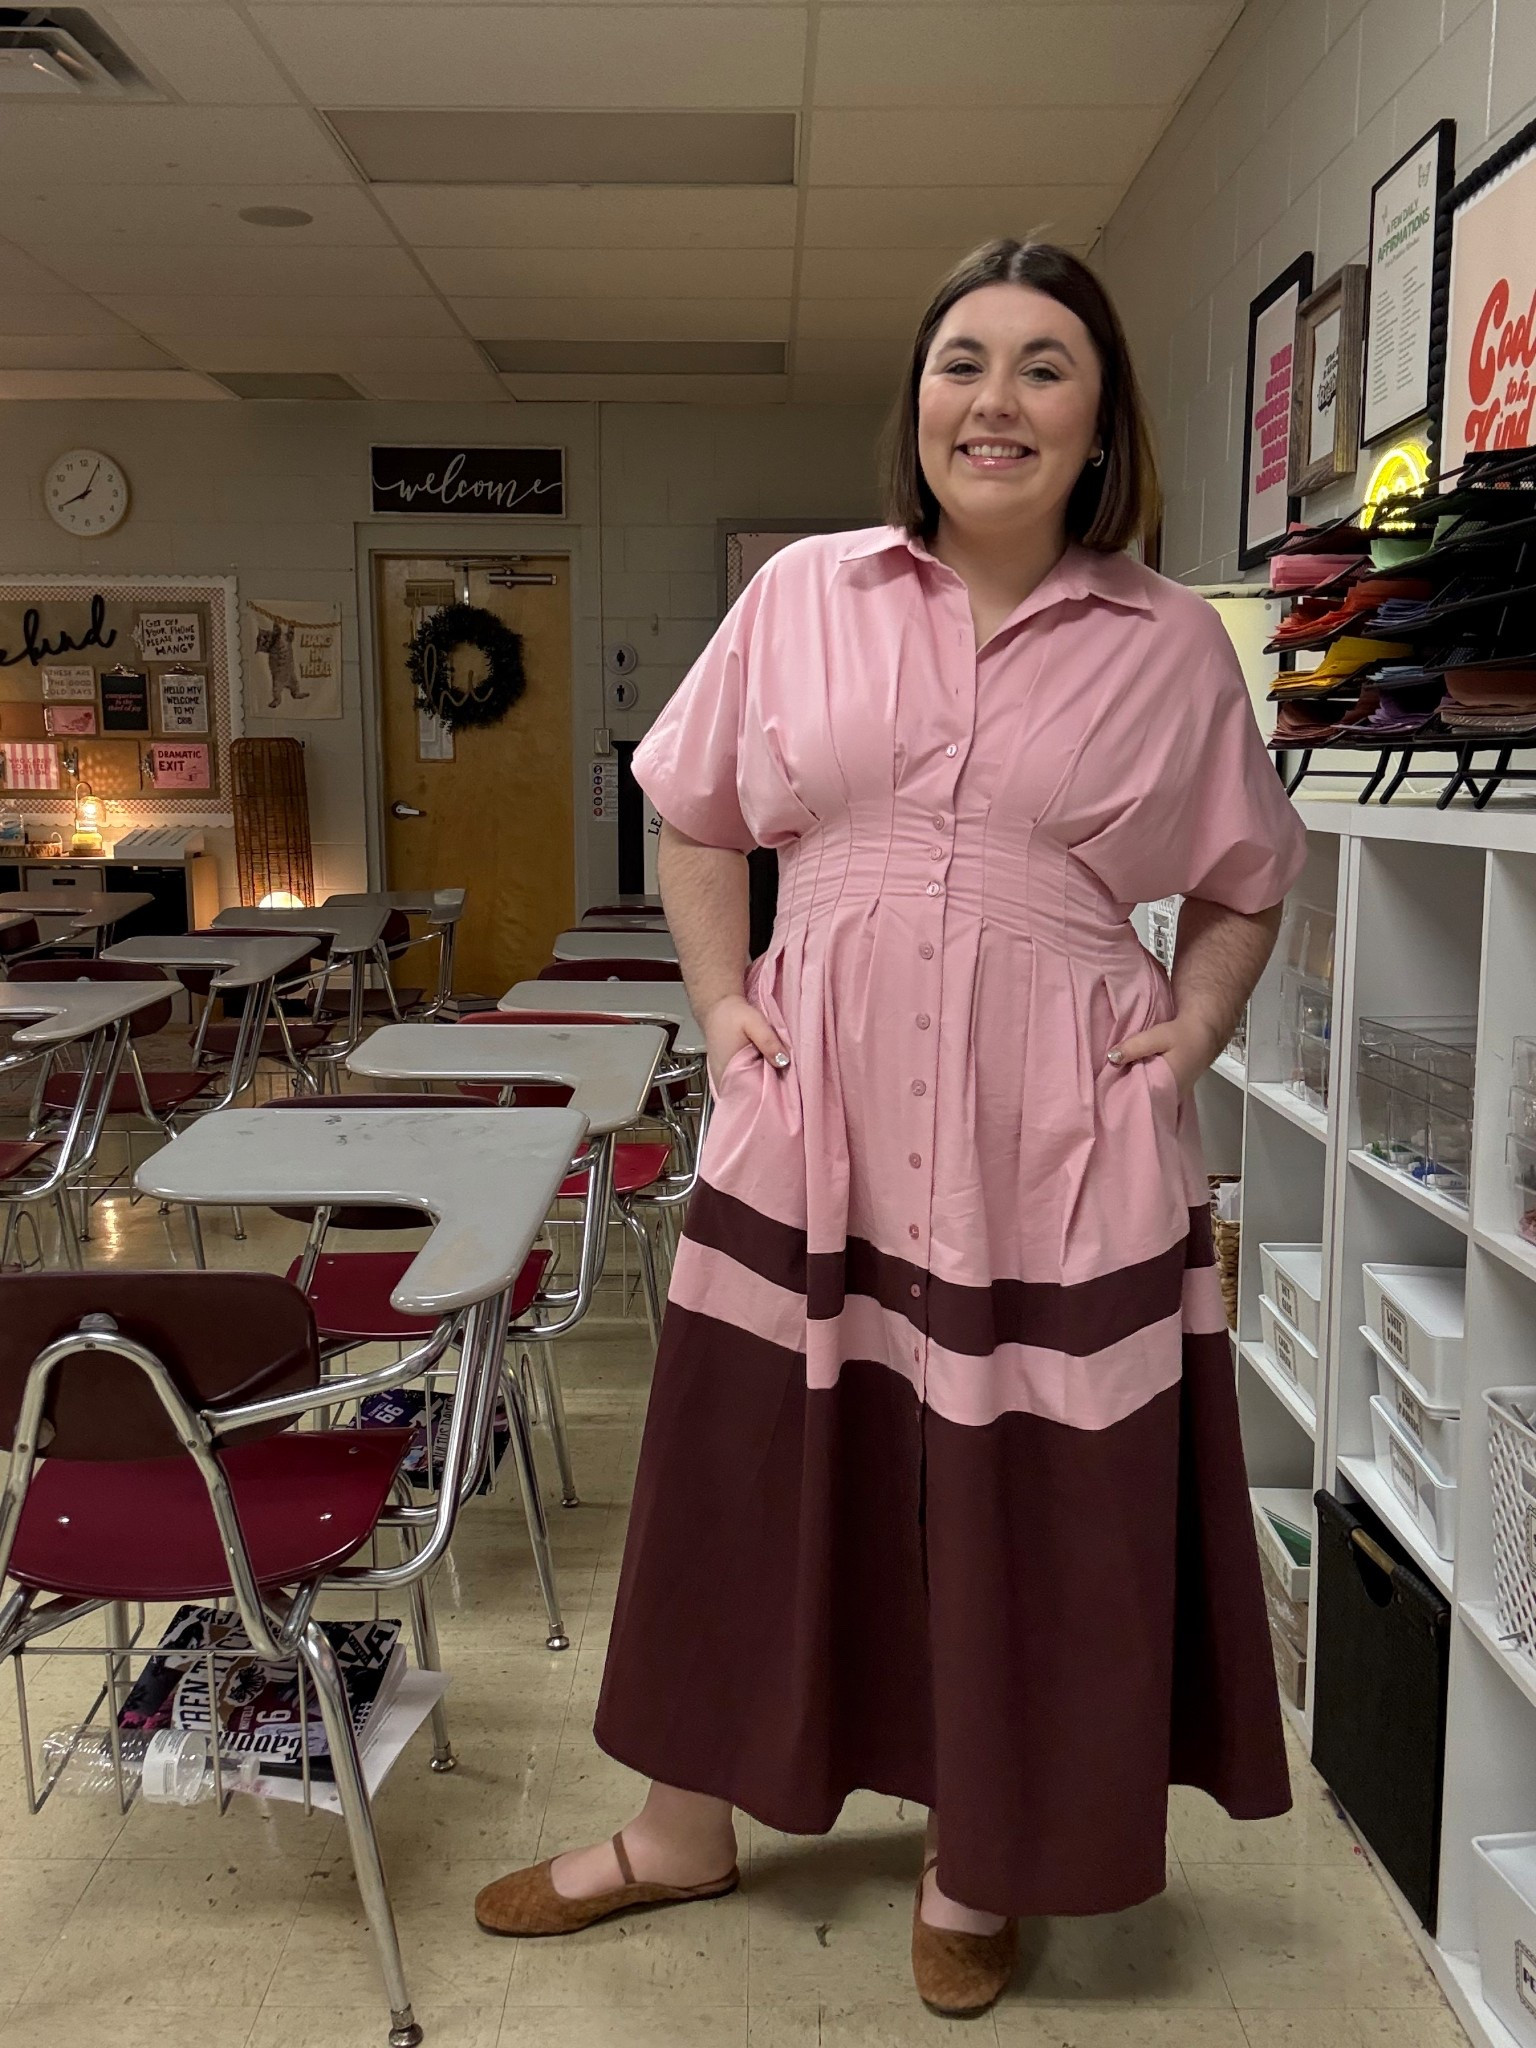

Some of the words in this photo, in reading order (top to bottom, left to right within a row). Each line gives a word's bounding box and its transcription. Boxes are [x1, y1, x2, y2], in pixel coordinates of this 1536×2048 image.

[1377, 206, 1430, 264] AFFIRMATIONS
[66, 463, 73, 471] 11
[80, 459, 88, 467] 12
[57, 474, 65, 482] 10
[107, 474, 113, 482] 2
[372, 454, 562, 508] welcome
[53, 489, 59, 497] 9
[112, 489, 118, 498] 3
[70, 514, 76, 523] 7
[100, 515, 105, 523] 5
[85, 519, 91, 527] 6
[146, 619, 160, 627] GET
[145, 627, 166, 638] YOUR
[170, 625, 194, 634] PHONE
[178, 634, 195, 642] AND
[300, 633, 333, 648] HANG
[155, 643, 188, 655] HANG
[300, 662, 332, 678] THERE
[164, 686, 184, 694] HELLO
[186, 686, 202, 694] MTV
[167, 696, 200, 704] WELCOME
[173, 707, 182, 715] TO
[177, 717, 192, 725] CRIB
[157, 750, 202, 759] DRAMATIC
[159, 760, 185, 772] EXIT
[375, 1404, 404, 1424] 66
